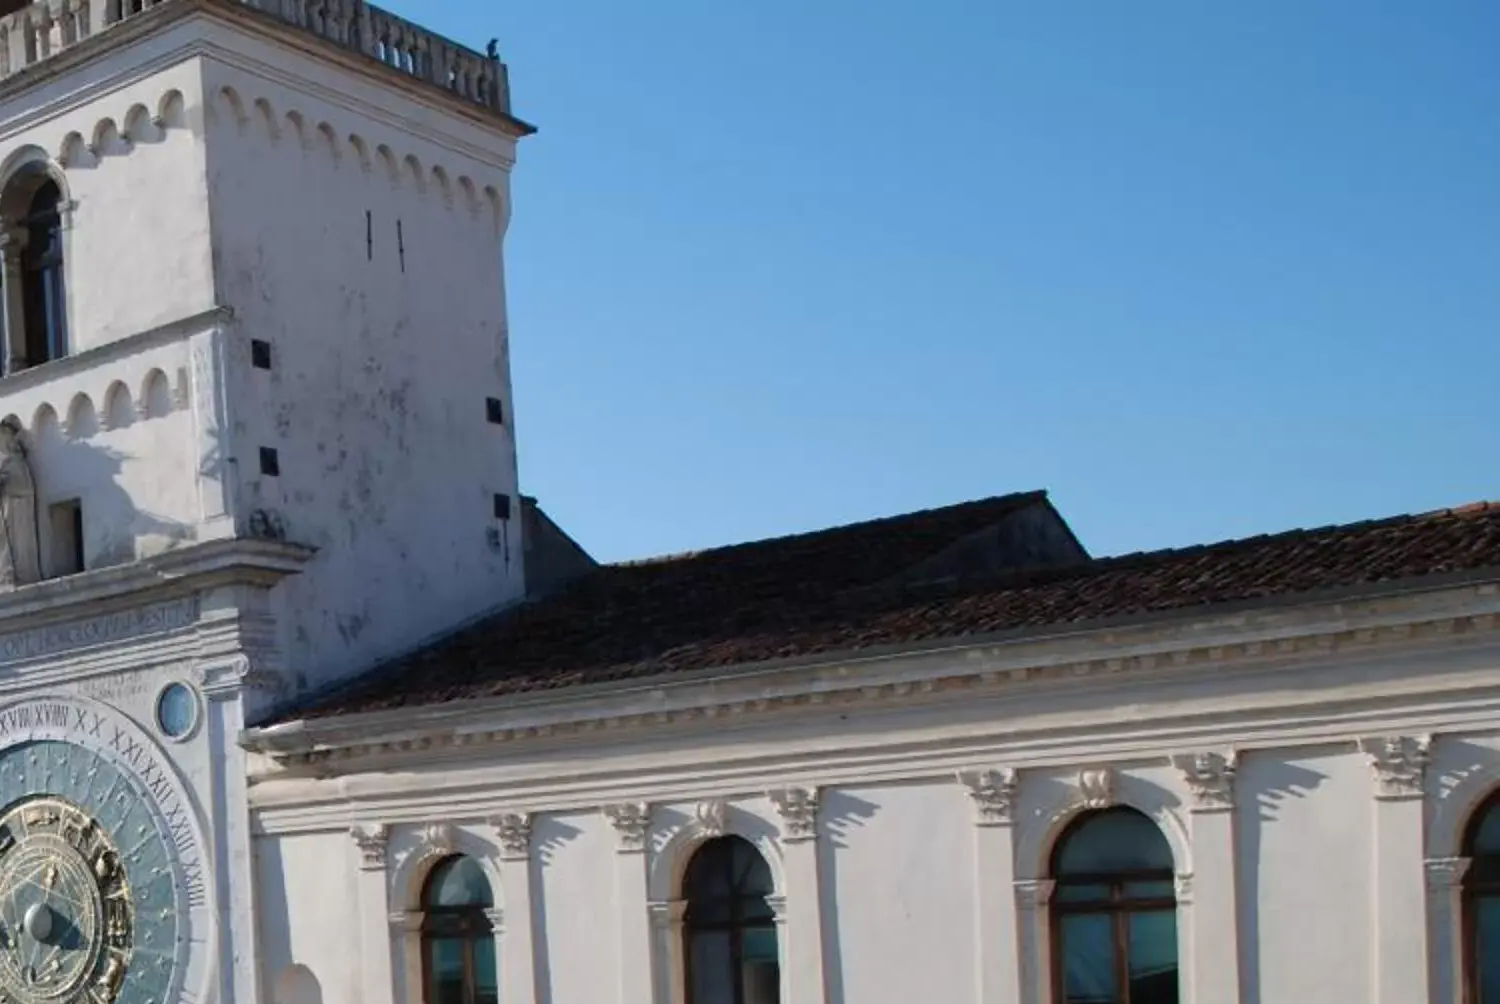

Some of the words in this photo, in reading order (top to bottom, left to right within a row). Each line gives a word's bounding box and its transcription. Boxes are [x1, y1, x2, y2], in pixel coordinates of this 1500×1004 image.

[74, 707, 107, 738] XX
[108, 726, 143, 764] XXI
[140, 757, 174, 803] XXII
[165, 802, 196, 853] XXIII
